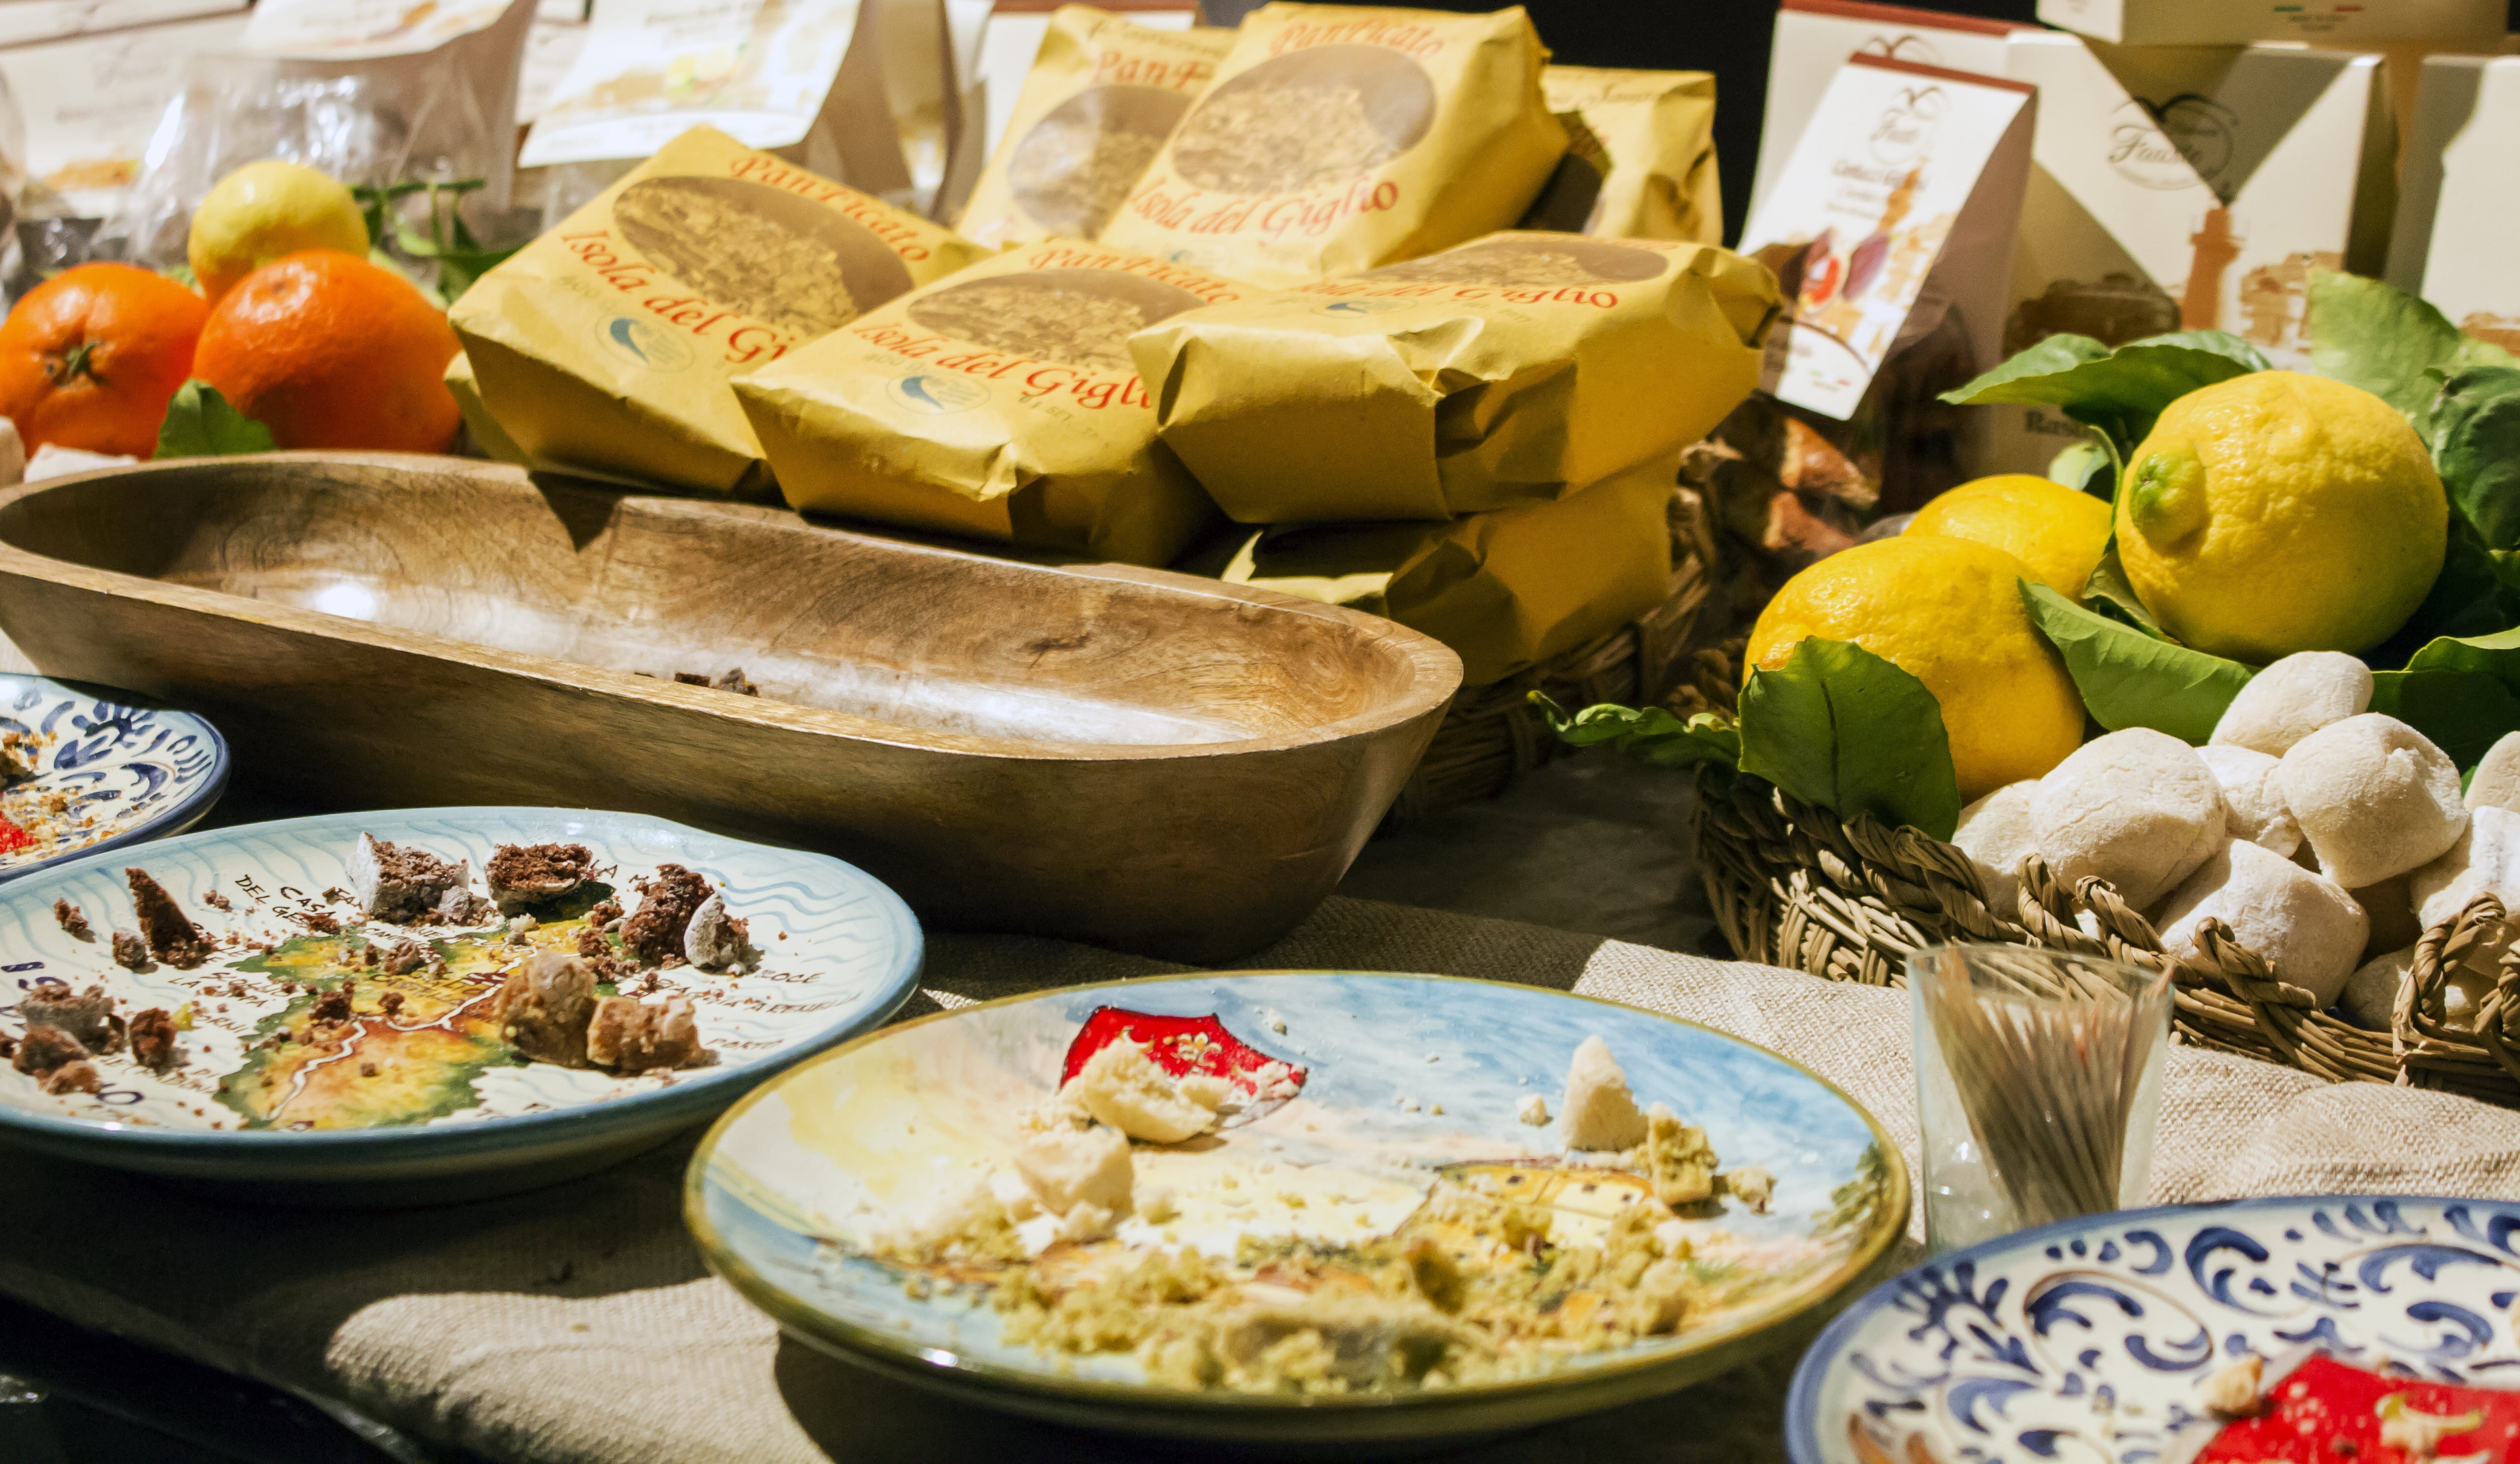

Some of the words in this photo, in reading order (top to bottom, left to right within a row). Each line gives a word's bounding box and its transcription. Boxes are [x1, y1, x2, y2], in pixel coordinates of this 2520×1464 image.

[1188, 195, 1272, 234] del
[1257, 175, 1400, 247] Giglio
[561, 230, 656, 294] Isola
[642, 296, 741, 336] del
[1450, 284, 1619, 309] Giglio
[852, 323, 950, 358] Isola
[935, 351, 1040, 379] del
[1021, 368, 1152, 410] Gigli
[235, 874, 270, 905] DEL
